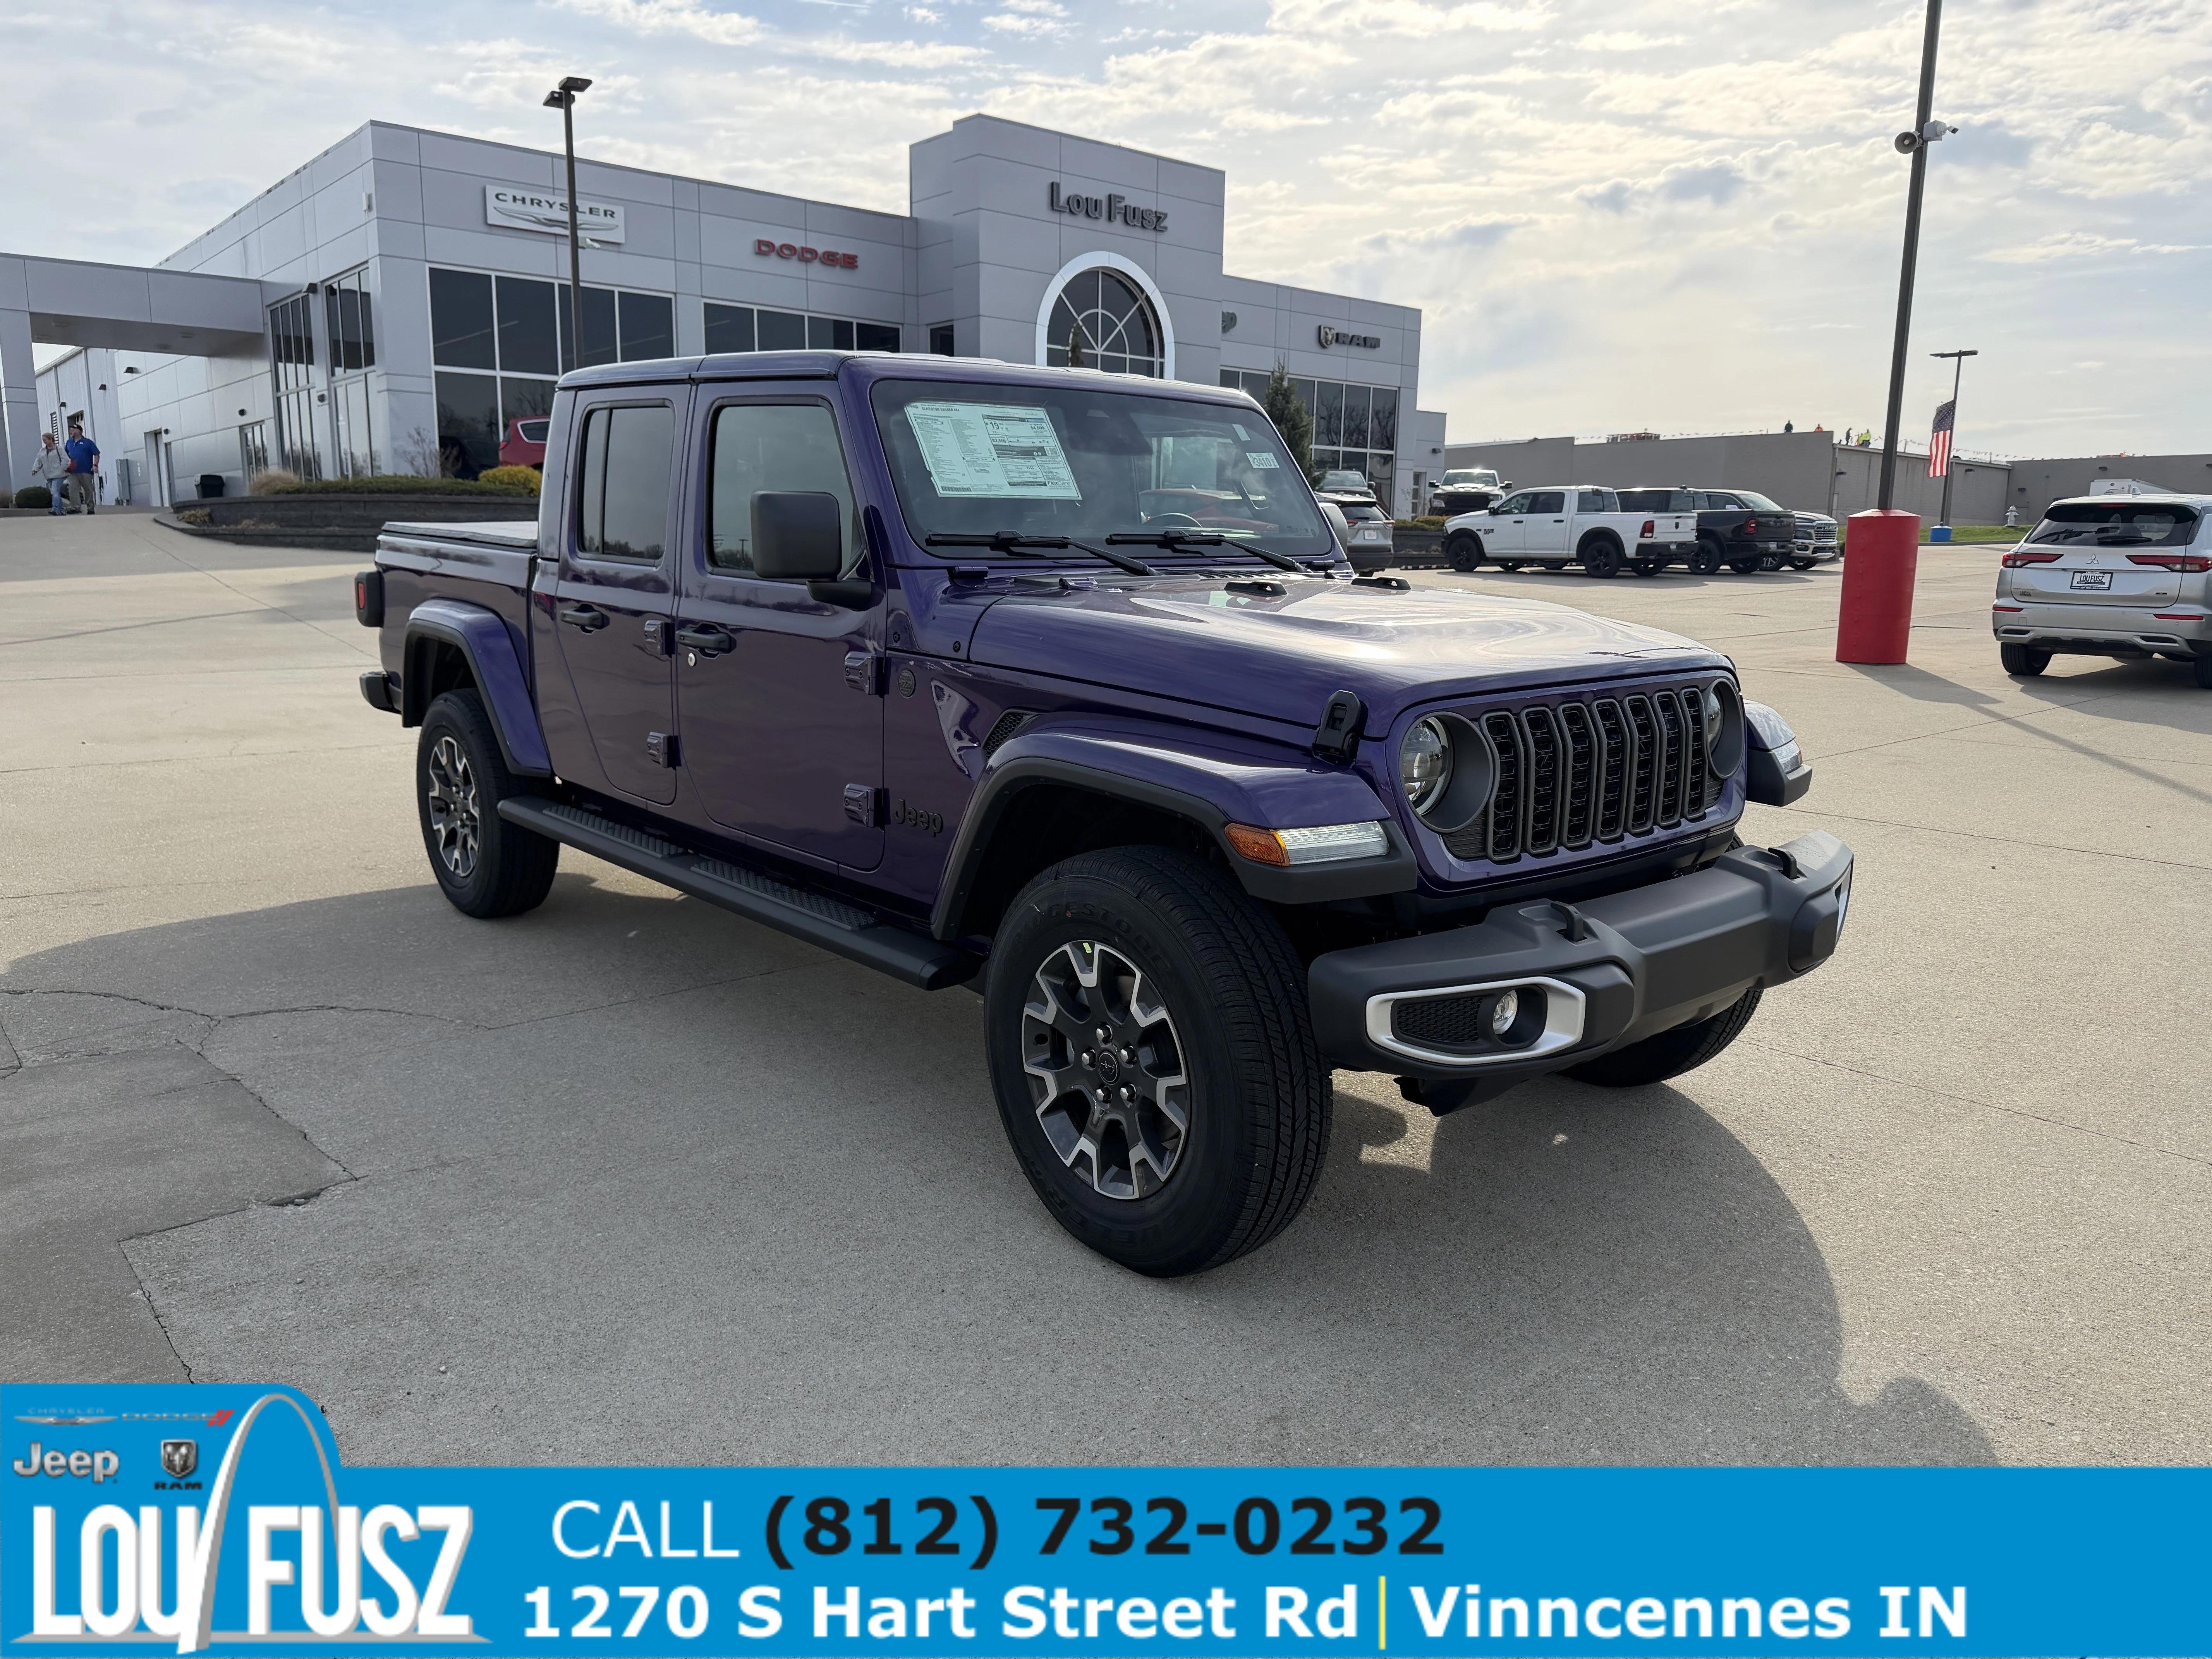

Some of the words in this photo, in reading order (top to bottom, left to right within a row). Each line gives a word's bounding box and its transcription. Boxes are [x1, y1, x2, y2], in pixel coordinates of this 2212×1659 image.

[495, 193, 616, 218] CHRYSLER
[1051, 181, 1103, 219] Lou
[1108, 193, 1168, 232] Fusz
[756, 239, 858, 269] DODGE
[1336, 332, 1381, 349] RAM
[892, 799, 943, 838] Jeep
